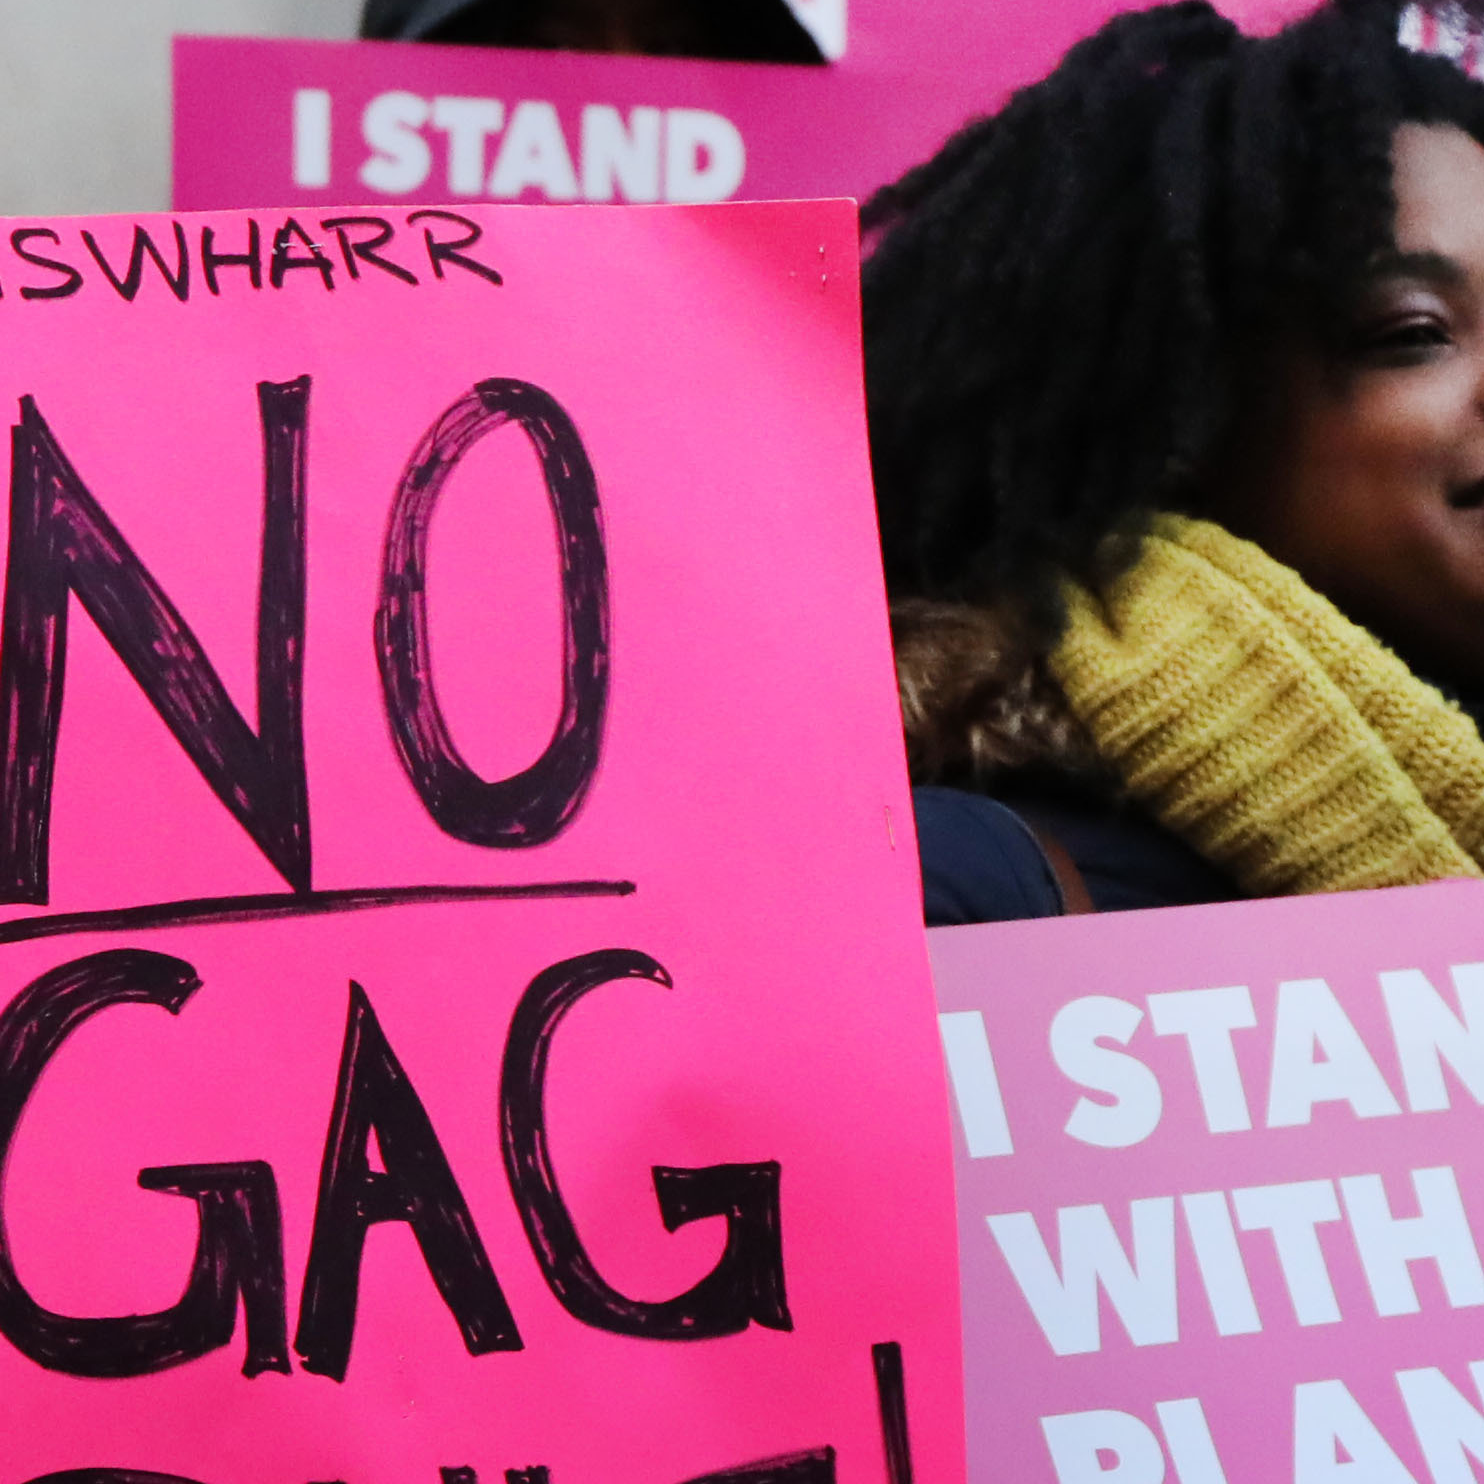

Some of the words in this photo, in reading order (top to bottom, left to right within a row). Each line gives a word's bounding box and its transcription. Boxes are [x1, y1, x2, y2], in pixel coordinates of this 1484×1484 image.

[293, 88, 331, 189] I
[361, 90, 746, 204] STAND
[936, 1009, 1015, 1160] I
